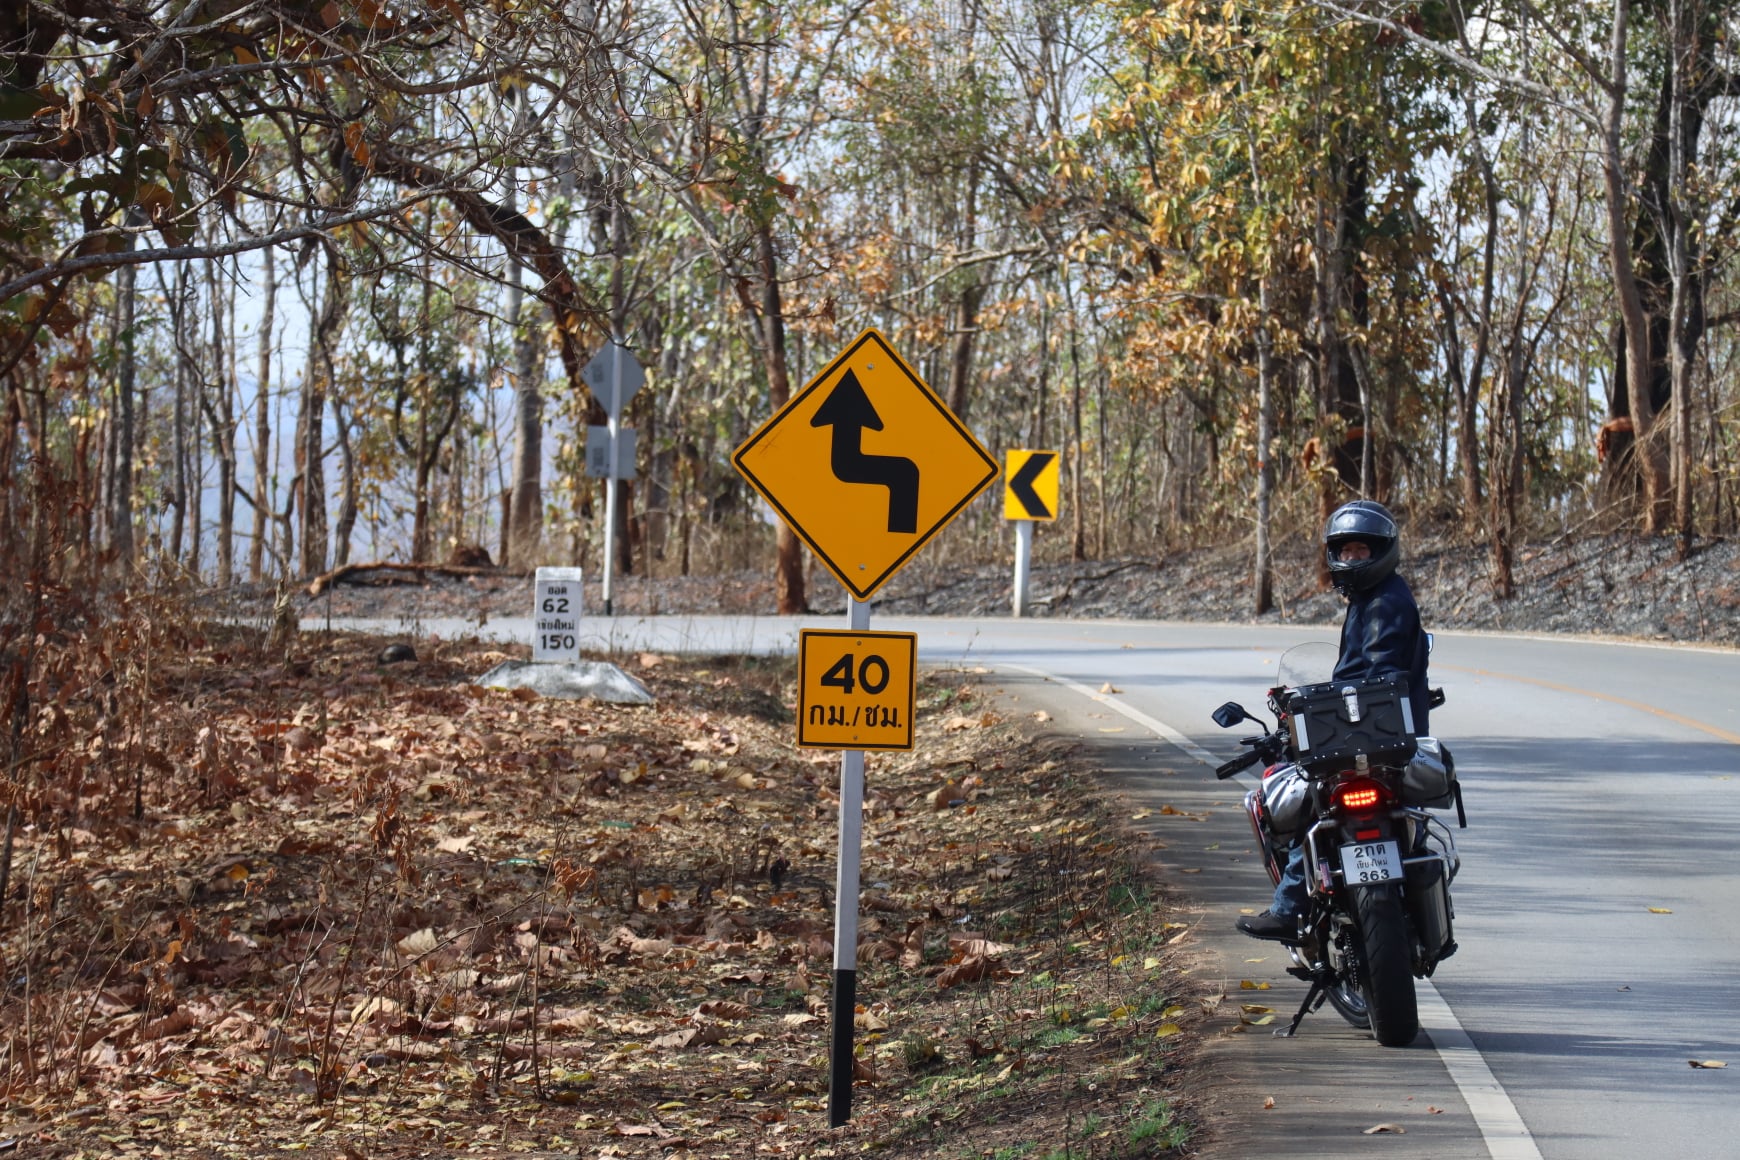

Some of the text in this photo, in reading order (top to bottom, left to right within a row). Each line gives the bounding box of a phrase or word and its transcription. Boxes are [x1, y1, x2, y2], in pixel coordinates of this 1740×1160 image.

[542, 598, 569, 613] 62
[537, 618, 575, 630] เชียงใหม่
[541, 634, 575, 650] 150
[820, 653, 890, 695] 40
[809, 704, 902, 728] กม./ชม.
[1356, 857, 1388, 869] เชียงใหม่
[1359, 868, 1390, 883] 363
